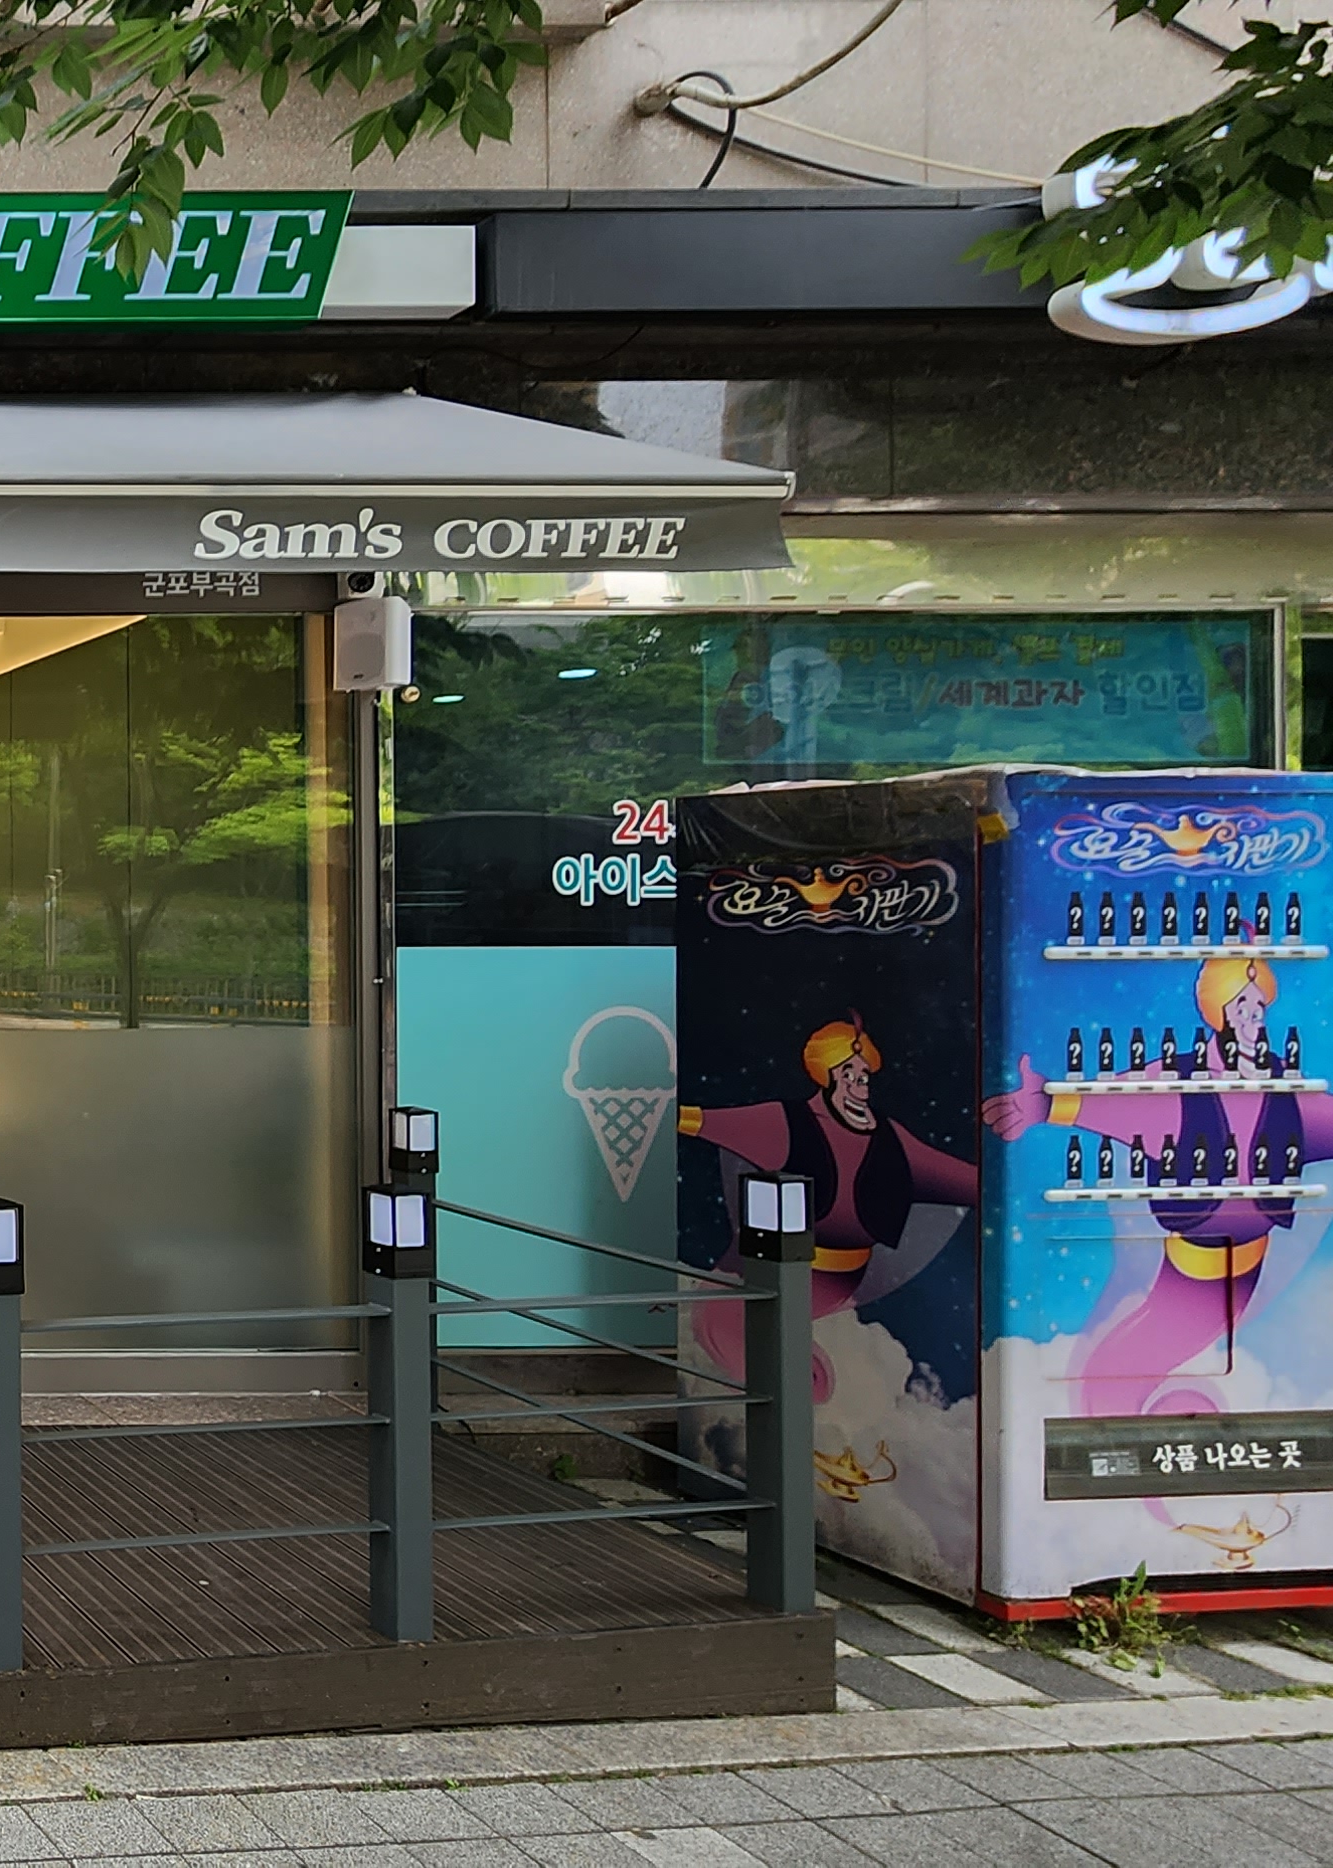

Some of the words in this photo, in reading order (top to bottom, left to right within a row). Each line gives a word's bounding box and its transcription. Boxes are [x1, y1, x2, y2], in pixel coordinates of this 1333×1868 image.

[193, 508, 403, 560] Sam's
[433, 517, 685, 560] COFFEE
[142, 571, 261, 598] 군포부곡점
[1095, 669, 1207, 716] 할인점
[612, 799, 676, 845] 24
[1152, 1443, 1198, 1474] 상품
[1204, 1442, 1273, 1471] 나오는
[1277, 1440, 1302, 1468] 곳
